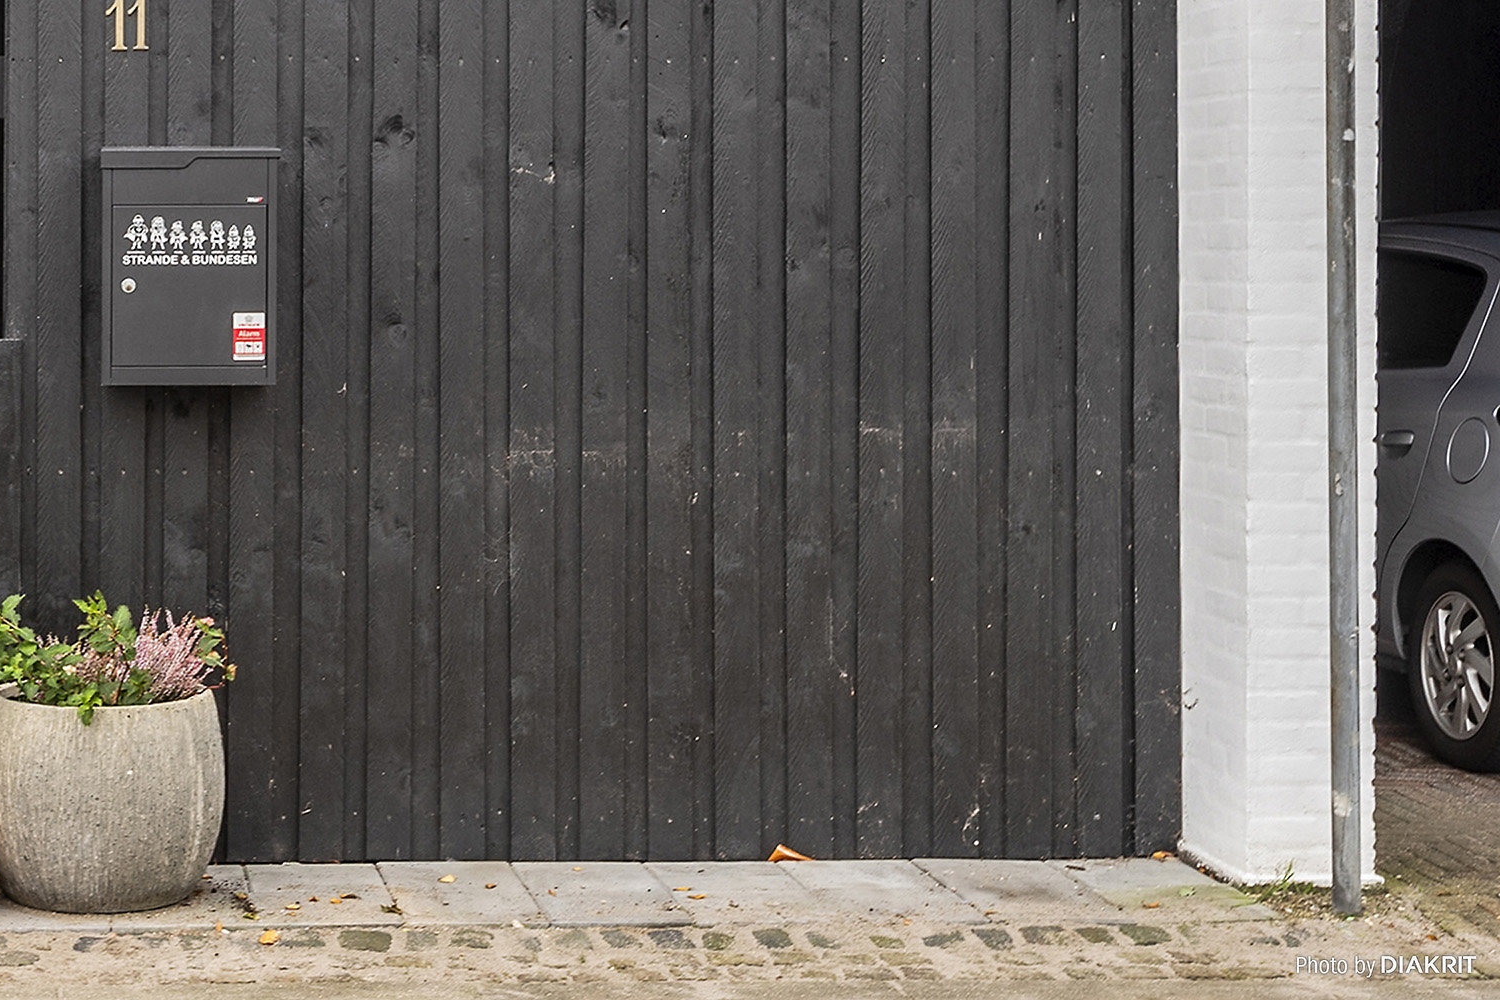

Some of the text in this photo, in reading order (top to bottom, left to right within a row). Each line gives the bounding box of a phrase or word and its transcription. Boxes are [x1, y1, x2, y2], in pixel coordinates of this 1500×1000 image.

[122, 254, 258, 265] STRANDE & BUNDESEN
[238, 329, 260, 337] Alarm
